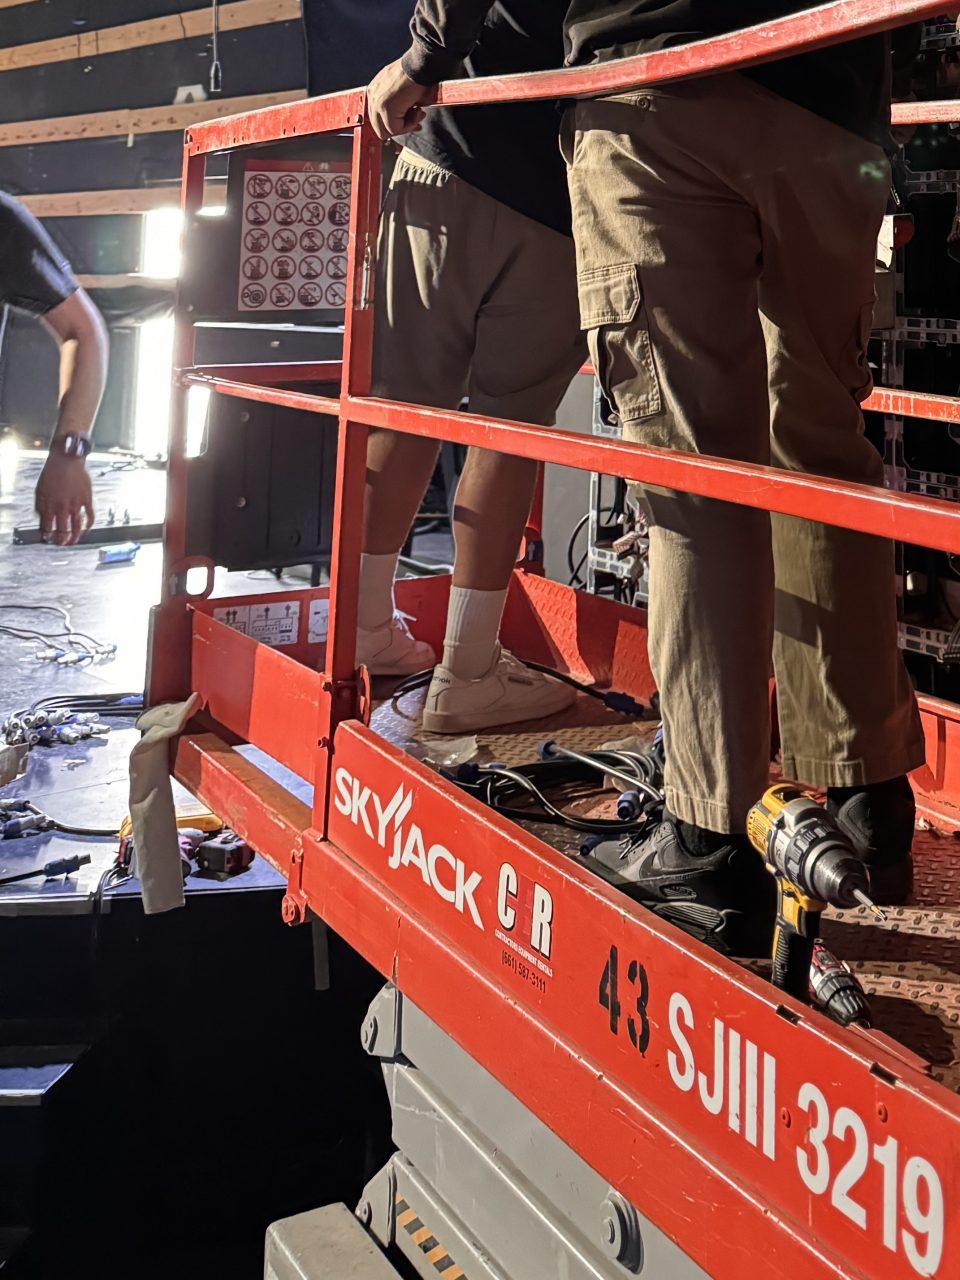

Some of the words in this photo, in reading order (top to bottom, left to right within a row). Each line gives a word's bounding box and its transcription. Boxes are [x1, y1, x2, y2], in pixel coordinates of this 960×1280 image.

[334, 767, 485, 932] SKYJACK
[598, 944, 650, 1058] 43
[667, 991, 776, 1162] SJIII
[796, 1082, 945, 1278] 3219
